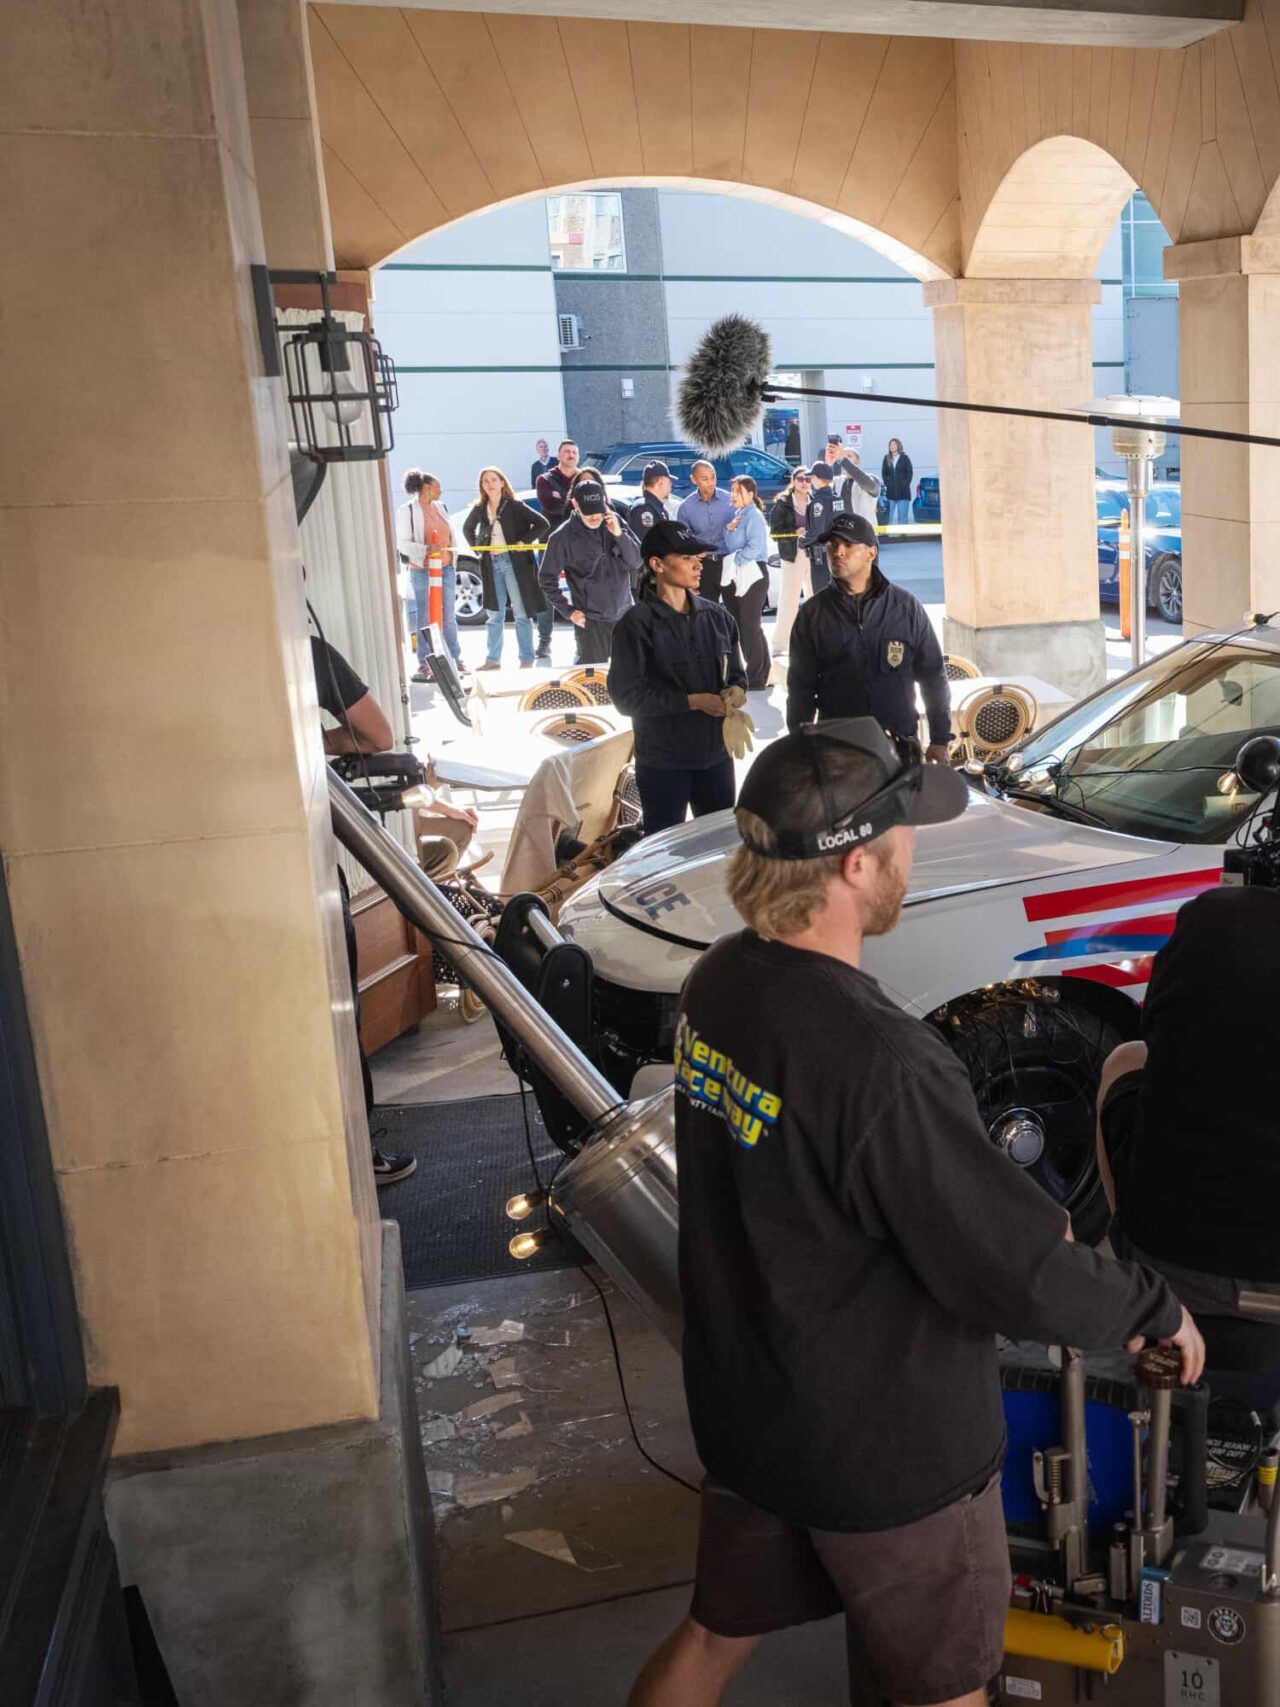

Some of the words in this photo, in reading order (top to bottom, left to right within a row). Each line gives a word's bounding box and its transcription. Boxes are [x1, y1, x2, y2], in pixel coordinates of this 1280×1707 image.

[583, 494, 601, 502] NCIS
[818, 829, 859, 851] LOCAL
[859, 822, 873, 837] 80
[684, 1024, 782, 1122] Ventura
[1142, 1582, 1154, 1622] ALTOIDS
[1181, 1670, 1204, 1689] 10
